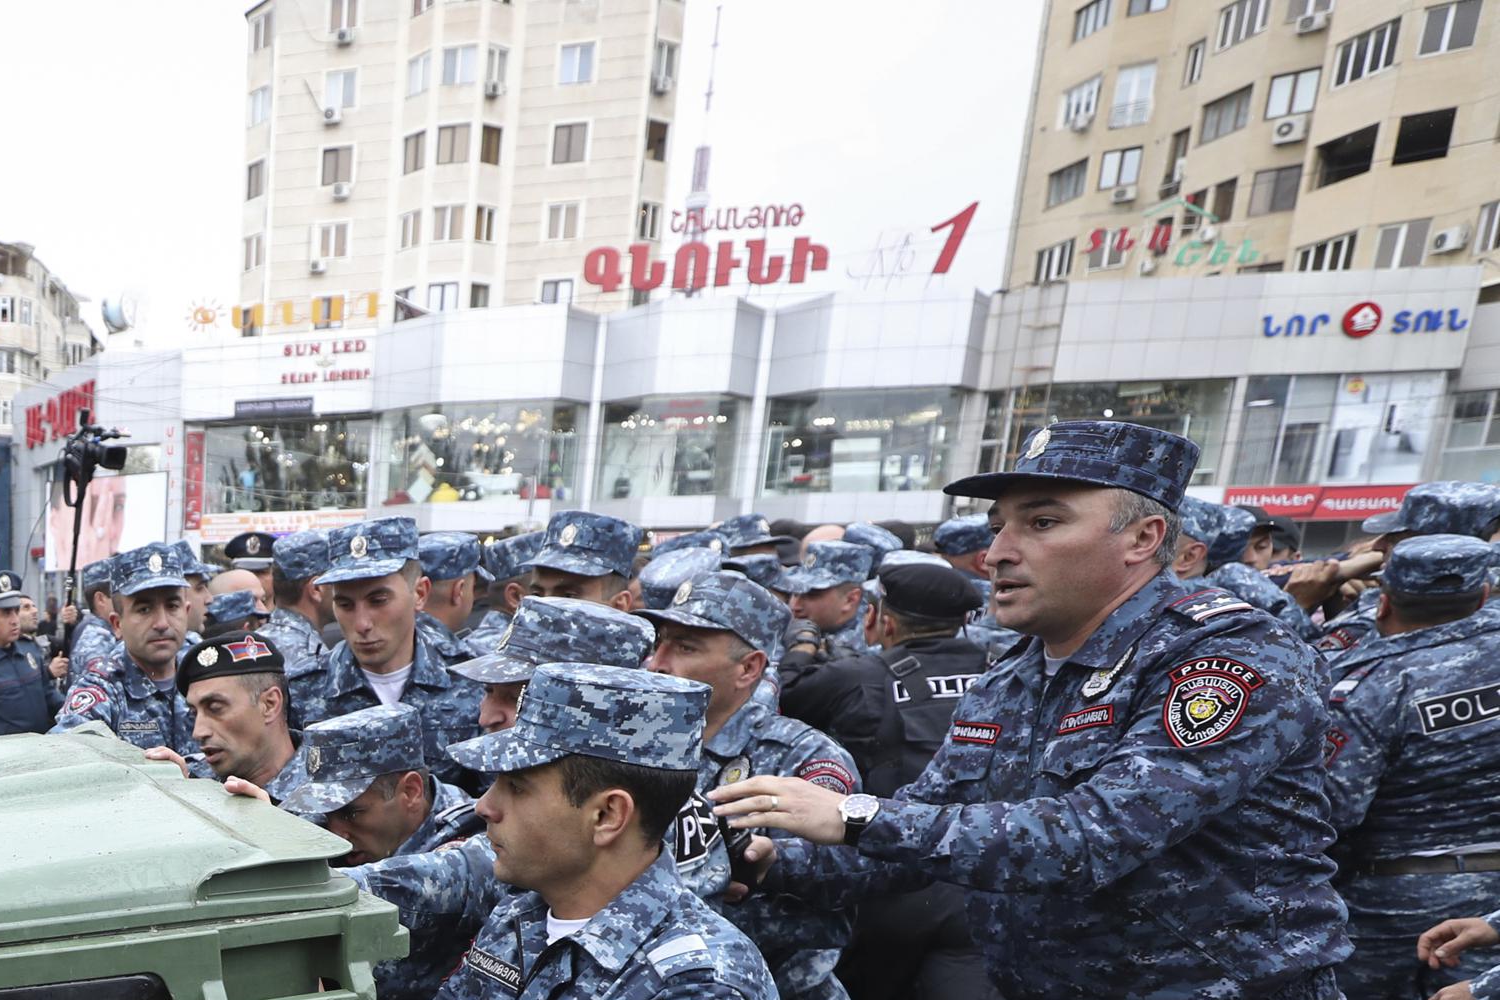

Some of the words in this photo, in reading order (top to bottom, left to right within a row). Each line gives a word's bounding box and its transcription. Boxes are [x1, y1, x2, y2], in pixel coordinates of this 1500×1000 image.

[670, 203, 805, 233] ՇԻՆԱՆՅՈՒԹ
[930, 200, 980, 274] 1
[584, 236, 830, 293] ԳՆՈՒՆԻ
[1262, 313, 1330, 338] ՆՈՐ
[1390, 308, 1469, 334] ՏՈՒՆ
[283, 342, 322, 357] SUN
[332, 338, 367, 354] LED
[1181, 660, 1255, 683] POLICE
[1180, 678, 1239, 699] ՀԱՅԱՍՏԱՆ
[1171, 702, 1236, 741] ՈՍՏԻԿԱՆՈՒԹՅՈՒՆ
[1425, 689, 1500, 728] POL
